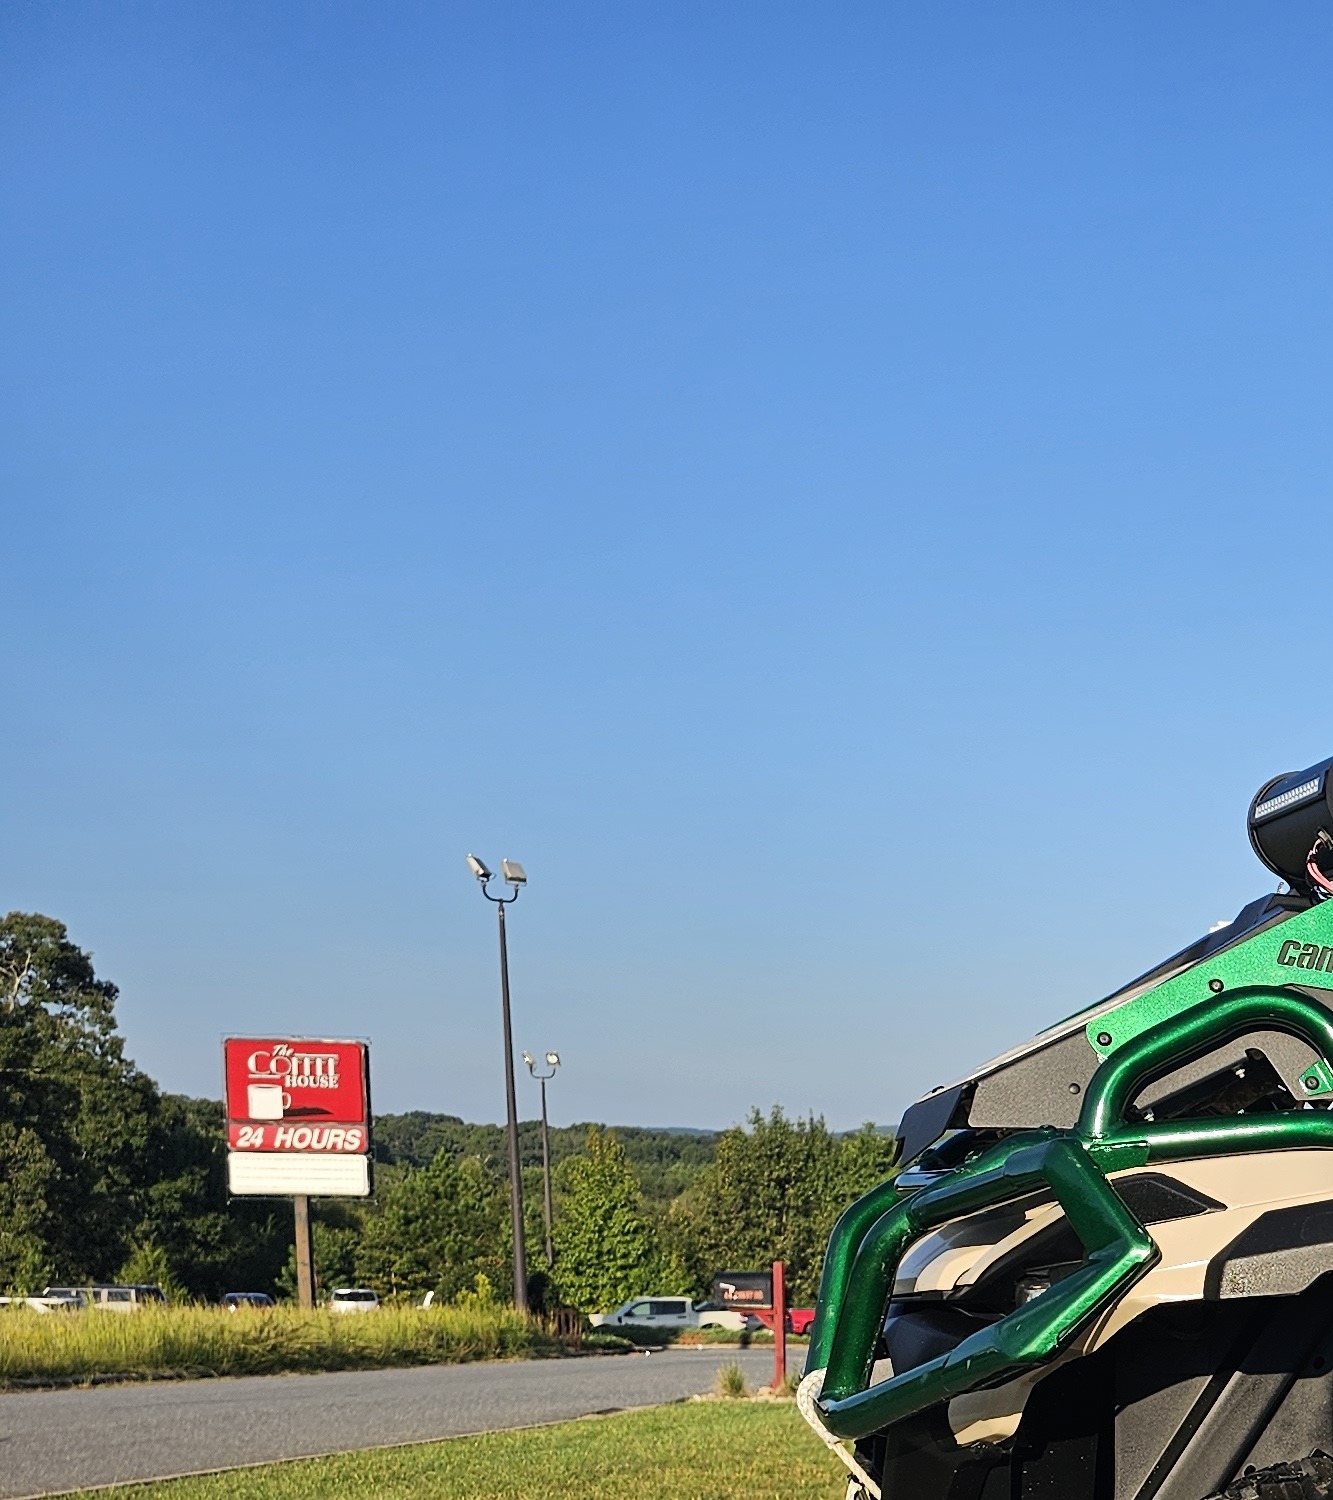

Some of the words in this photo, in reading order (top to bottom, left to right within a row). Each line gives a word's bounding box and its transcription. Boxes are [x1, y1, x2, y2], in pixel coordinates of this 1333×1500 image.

[284, 1074, 340, 1089] HOUSE
[235, 1126, 265, 1149] 24
[273, 1126, 363, 1151] HOURS
